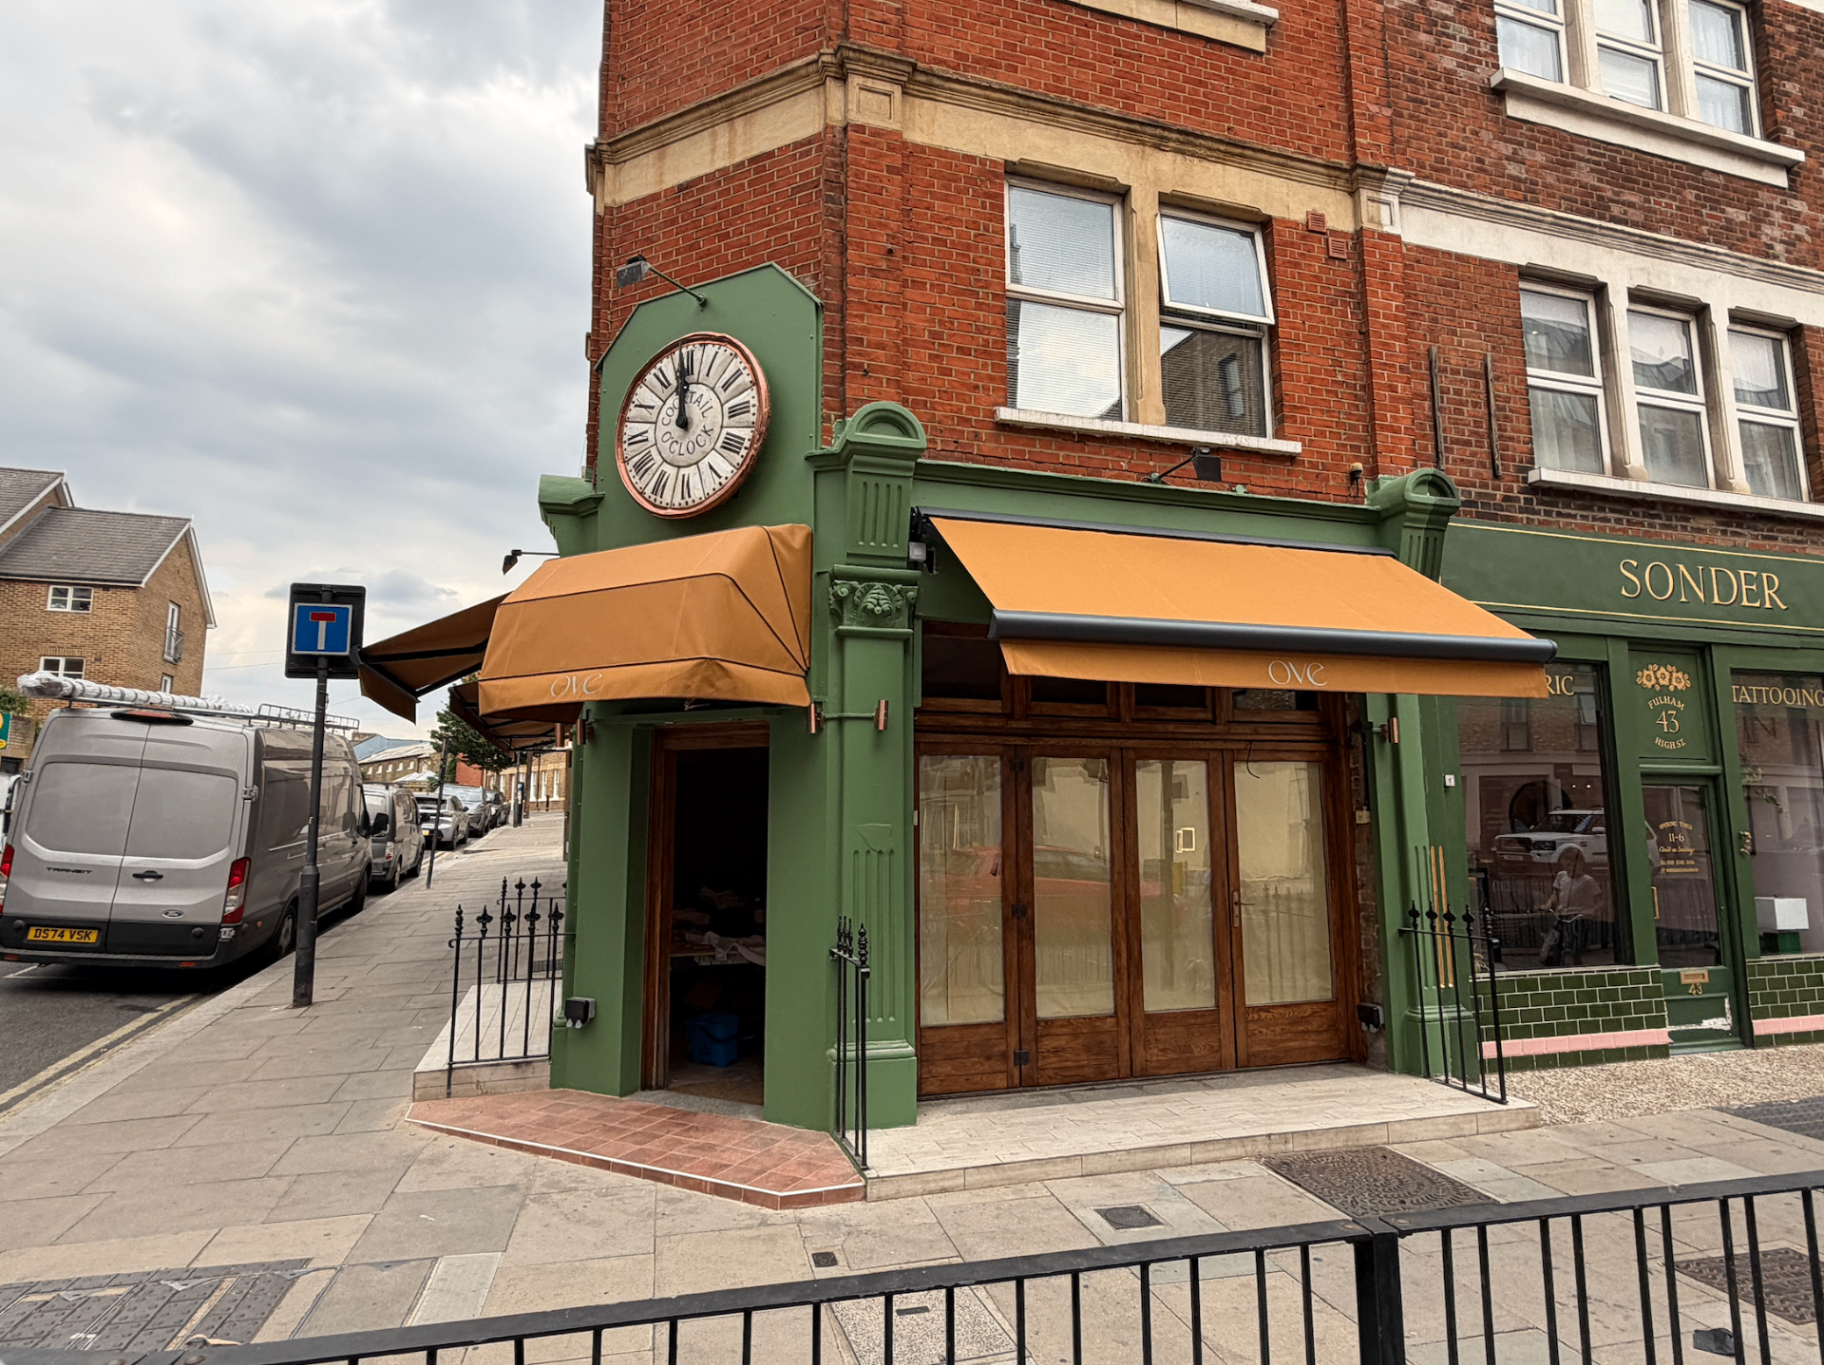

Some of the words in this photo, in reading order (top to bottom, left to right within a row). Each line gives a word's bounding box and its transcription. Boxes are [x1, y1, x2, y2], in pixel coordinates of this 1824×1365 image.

[1619, 558, 1788, 610] SONDER
[1545, 674, 1575, 696] RIC
[1731, 685, 1824, 707] TATTOOING
[1647, 696, 1686, 711] FULHAM
[1655, 710, 1681, 733] 43
[1654, 736, 1677, 750] HIGH
[33, 928, 66, 939] DS74
[69, 930, 93, 941] VSK
